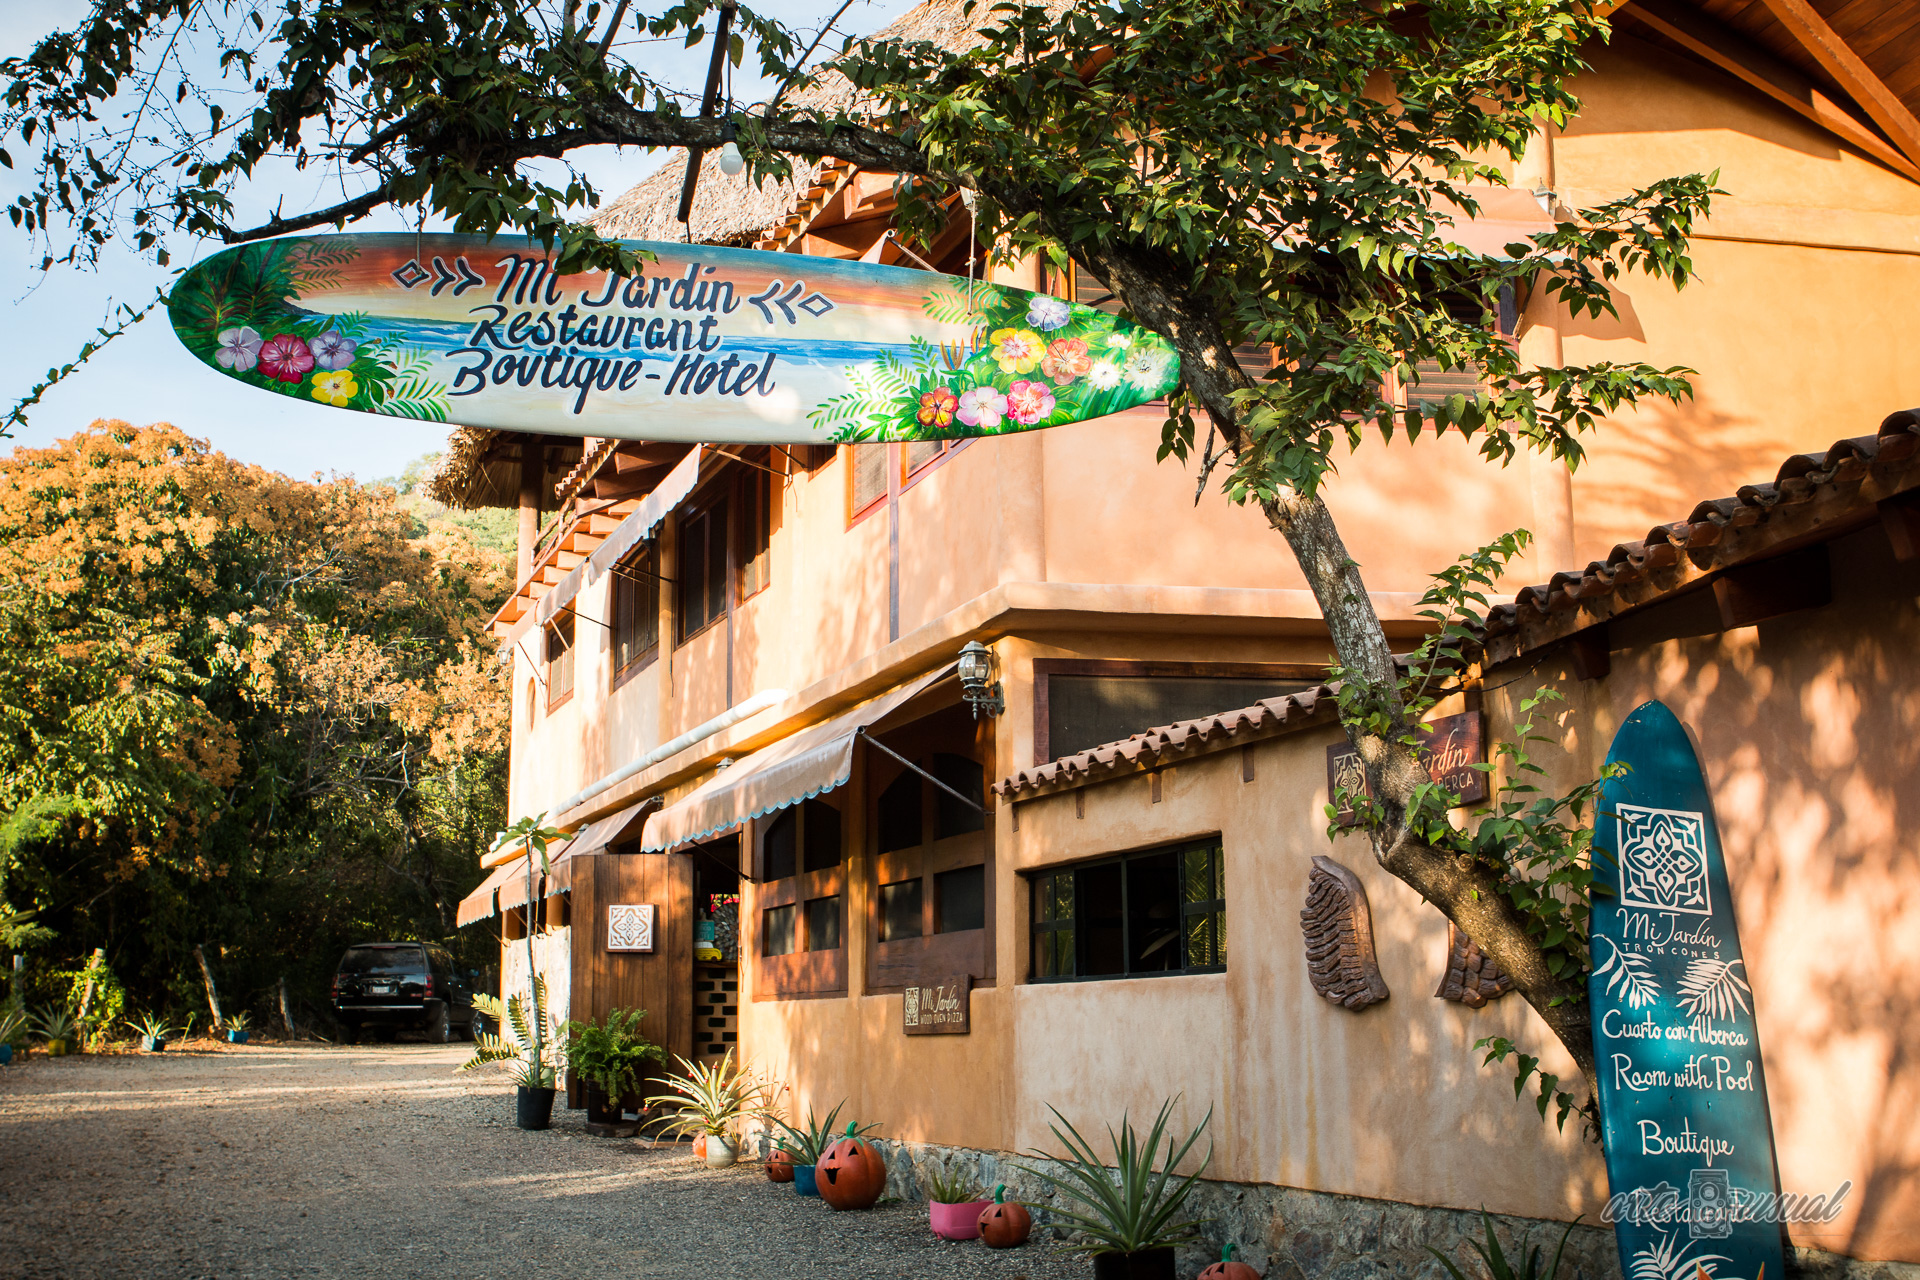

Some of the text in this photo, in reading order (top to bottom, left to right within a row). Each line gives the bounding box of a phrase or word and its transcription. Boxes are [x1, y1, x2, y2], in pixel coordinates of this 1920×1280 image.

[497, 253, 563, 306] Mi
[468, 304, 720, 353] Restaurant
[1616, 908, 1722, 948] Mi Jardín
[1622, 942, 1720, 960] TRONCONES
[921, 988, 934, 1010] Mi
[934, 1013, 946, 1023] OVEN
[947, 1012, 963, 1023] PIZZA
[1602, 1009, 1749, 1046] Cuarto con Alberca
[1611, 1053, 1754, 1092] Room with Pool
[1637, 1117, 1734, 1167] Boutique
[1630, 1187, 1755, 1233] Restaurante
